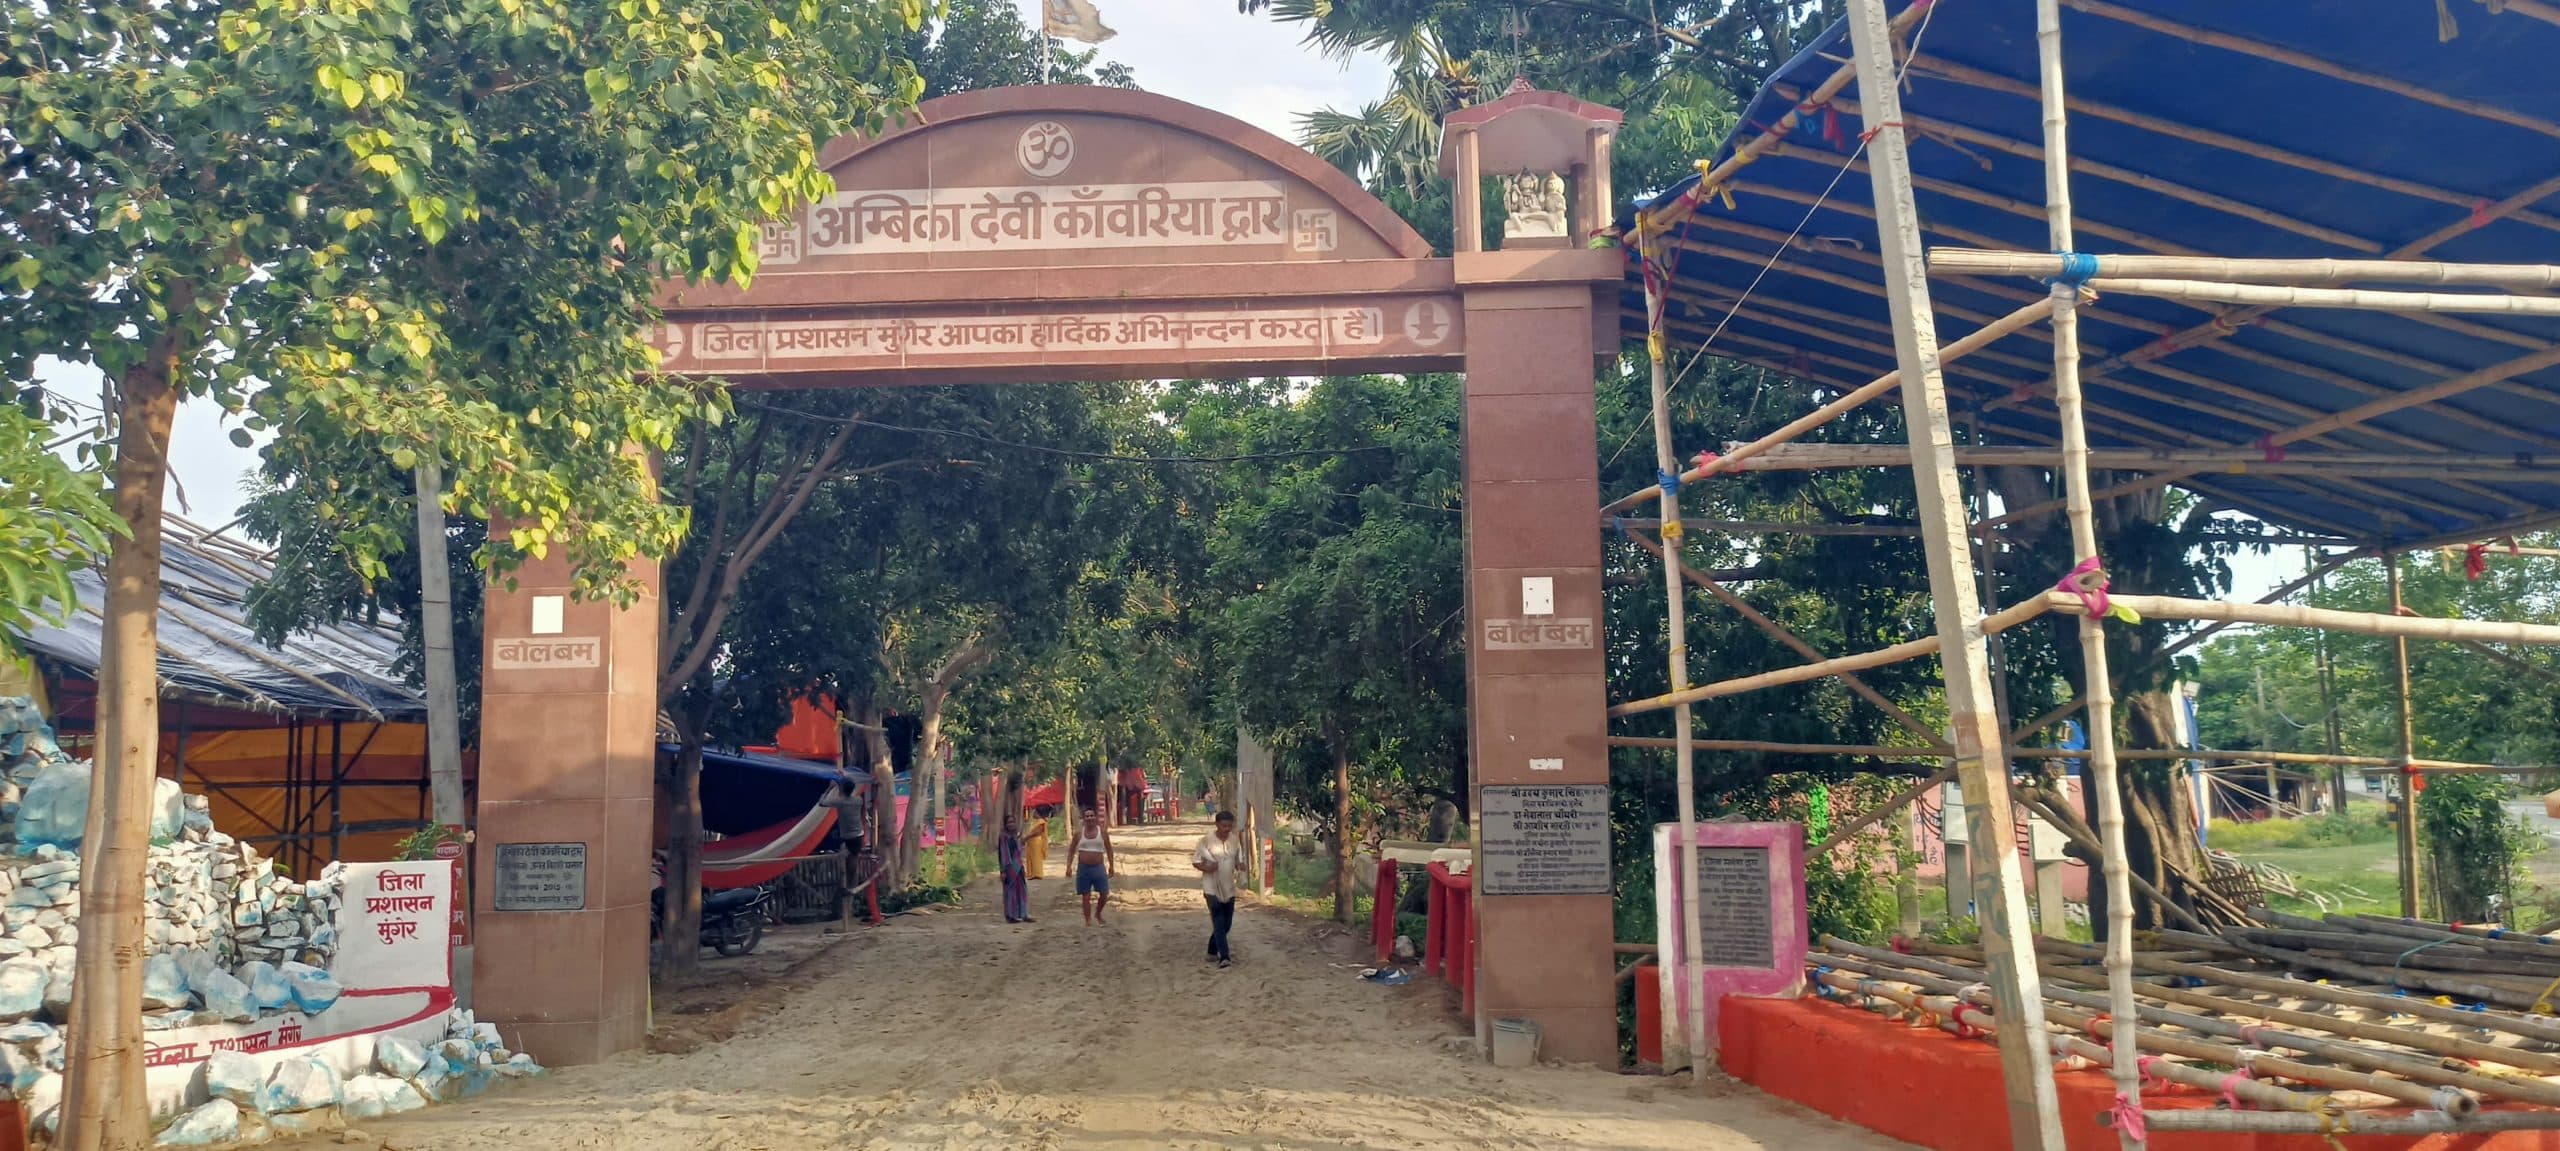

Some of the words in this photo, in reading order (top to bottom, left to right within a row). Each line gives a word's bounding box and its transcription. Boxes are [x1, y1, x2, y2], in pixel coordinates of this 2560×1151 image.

[811, 193, 966, 248] अम्बिका
[971, 191, 1047, 244] देवी
[1052, 186, 1217, 239] काँवरिया
[1220, 195, 1284, 242] द्वार
[702, 323, 771, 353] जिला
[775, 327, 873, 350] प्रशासन
[877, 319, 937, 352] मुंगेर
[938, 323, 1027, 347] आपका
[1030, 315, 1111, 348] हार्दिक
[1115, 314, 1255, 345] अभिनन्दन
[1258, 317, 1338, 340] करता
[498, 640, 552, 662] बोल
[376, 869, 426, 892] जिला
[366, 896, 435, 914] प्रशासन
[377, 917, 419, 945] मुंगेर
